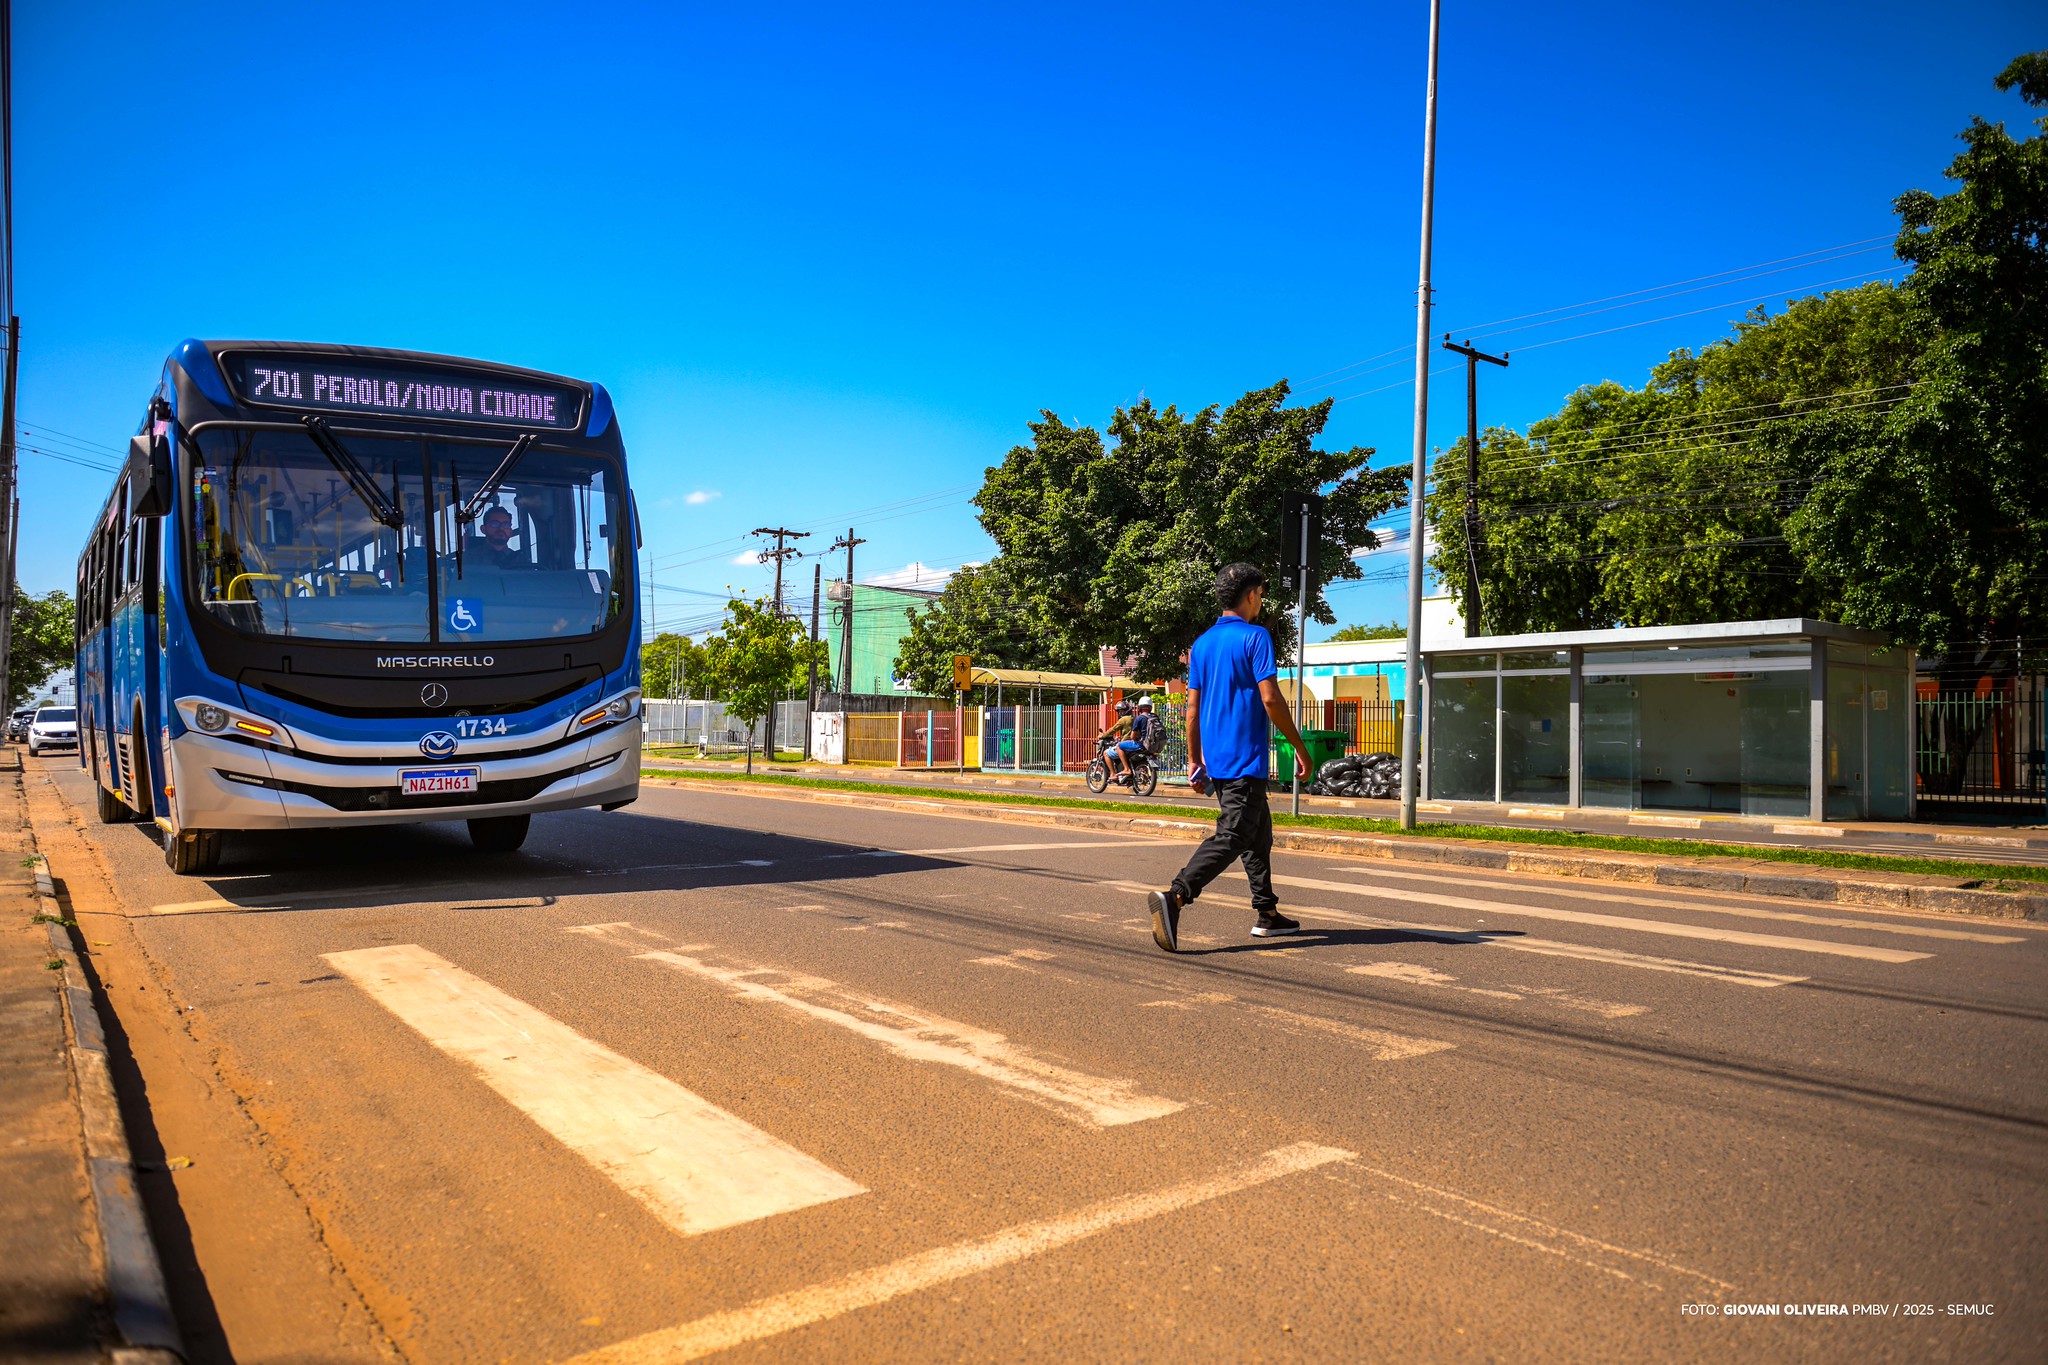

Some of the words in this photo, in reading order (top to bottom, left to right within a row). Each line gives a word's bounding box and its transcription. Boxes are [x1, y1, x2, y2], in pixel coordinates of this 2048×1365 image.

[254, 368, 303, 399] 701
[313, 374, 473, 414] PEROLA/NOVA
[480, 389, 556, 421] CIDADE
[376, 656, 495, 668] MASCARELLO
[456, 717, 507, 737] 1734
[410, 776, 470, 792] NAZ1H61
